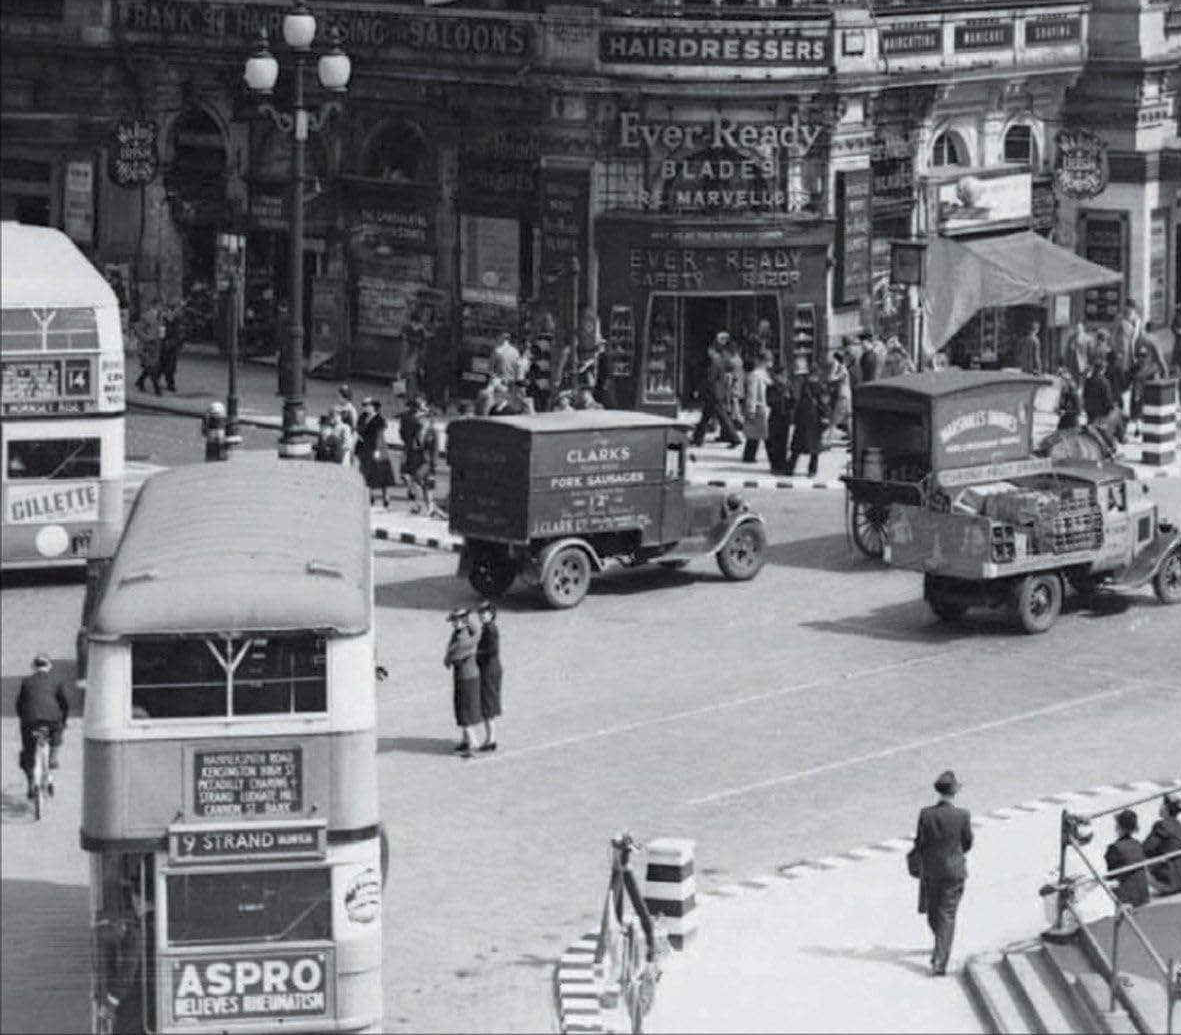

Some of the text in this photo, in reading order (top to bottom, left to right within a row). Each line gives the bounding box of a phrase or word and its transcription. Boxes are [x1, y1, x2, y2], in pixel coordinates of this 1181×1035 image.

[409, 19, 524, 53] SALOONS
[609, 35, 826, 61] HAIRDRESSERS
[660, 159, 777, 181] BLADES
[630, 248, 698, 269] EVER
[725, 248, 801, 269] READY
[742, 270, 801, 287] RAZOR
[69, 370, 86, 389] 14
[566, 445, 631, 464] CLARKS
[550, 471, 645, 489] PORK SAUSAGES
[11, 485, 97, 522] GILLETTE
[182, 834, 196, 852] 9
[202, 831, 275, 851] STRAND
[174, 991, 325, 1016] RELIEVES RHEUMATISM
